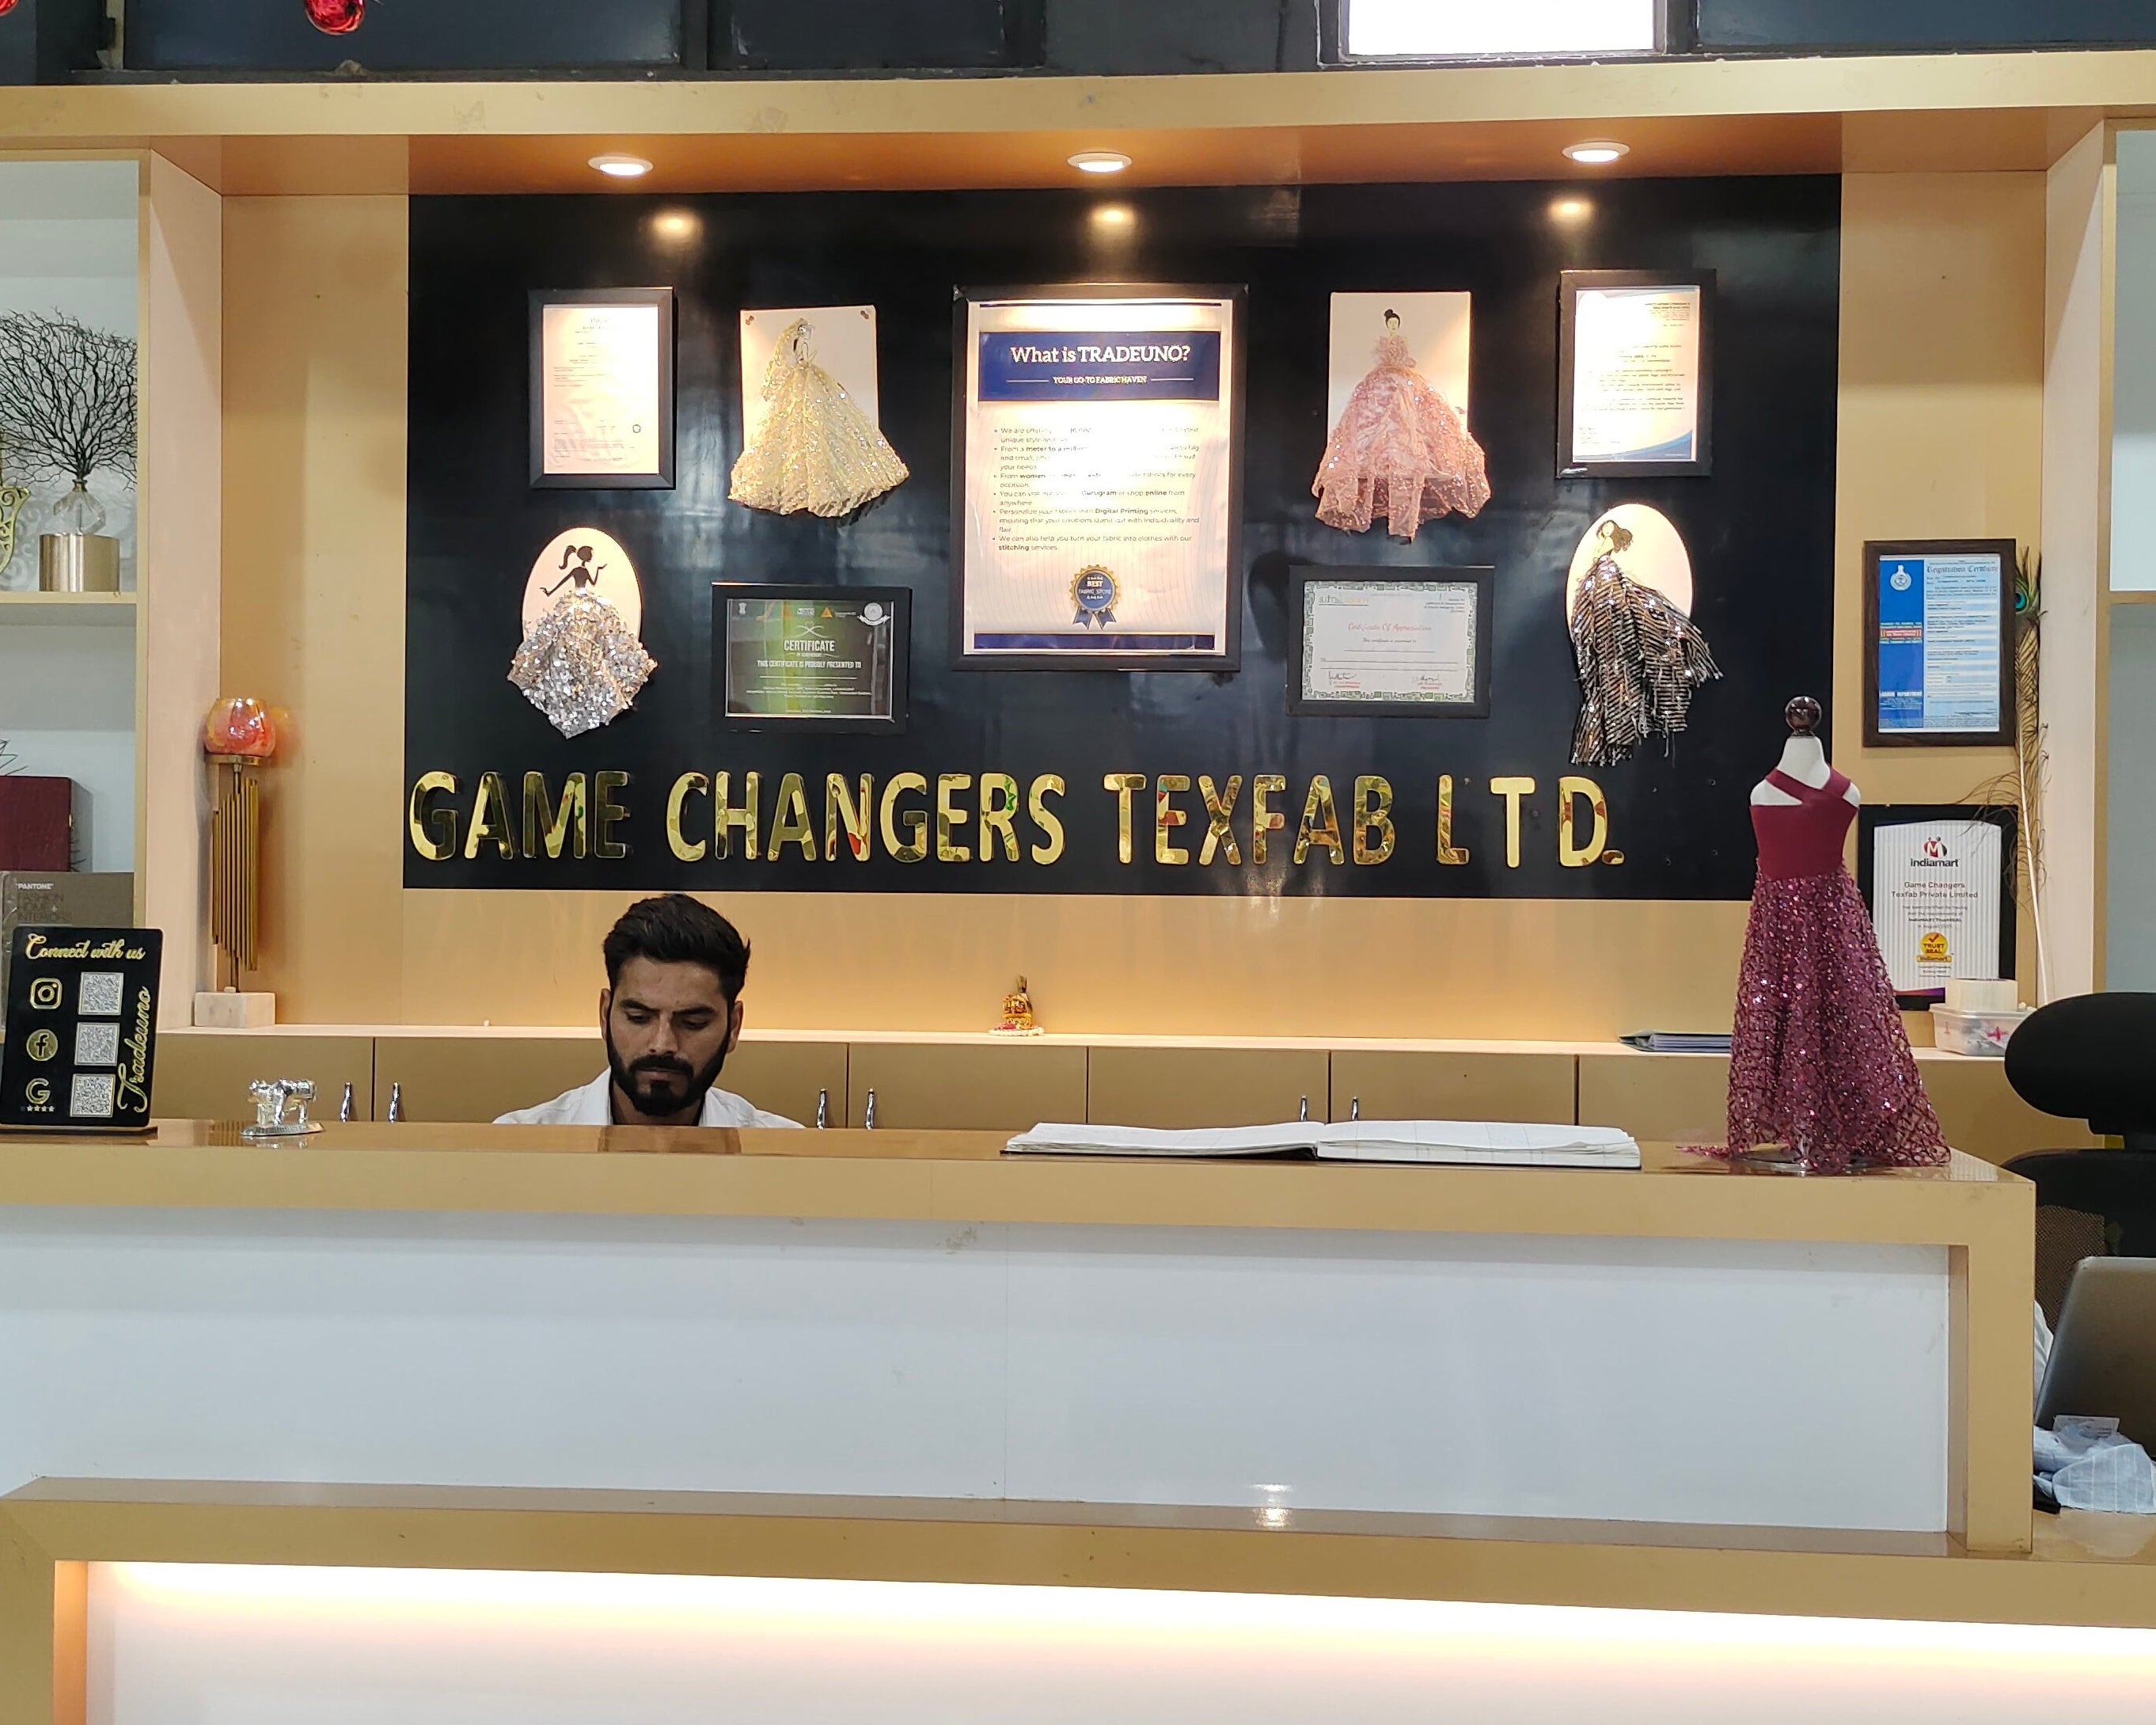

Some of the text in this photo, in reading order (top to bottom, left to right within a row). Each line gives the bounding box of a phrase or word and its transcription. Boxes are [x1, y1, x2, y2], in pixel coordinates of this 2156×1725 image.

[1010, 344, 1191, 363] What is TRADEUNO?
[1053, 376, 1073, 386] YOUR
[1095, 375, 1122, 385] FABRIC
[1121, 374, 1148, 384] HAVEN
[1119, 507, 1149, 515] Printing
[784, 640, 836, 652] CERTIFICATE
[408, 770, 631, 862] GAME
[666, 771, 1067, 866] CHANGERS
[1103, 773, 1396, 868] TEXFAB
[1910, 858, 1959, 868] indiamart
[17, 882, 54, 891] PANTONE
[1927, 880, 1965, 890] Changers
[26, 933, 146, 960] Connect with us
[116, 986, 151, 1113] Tradeuno
